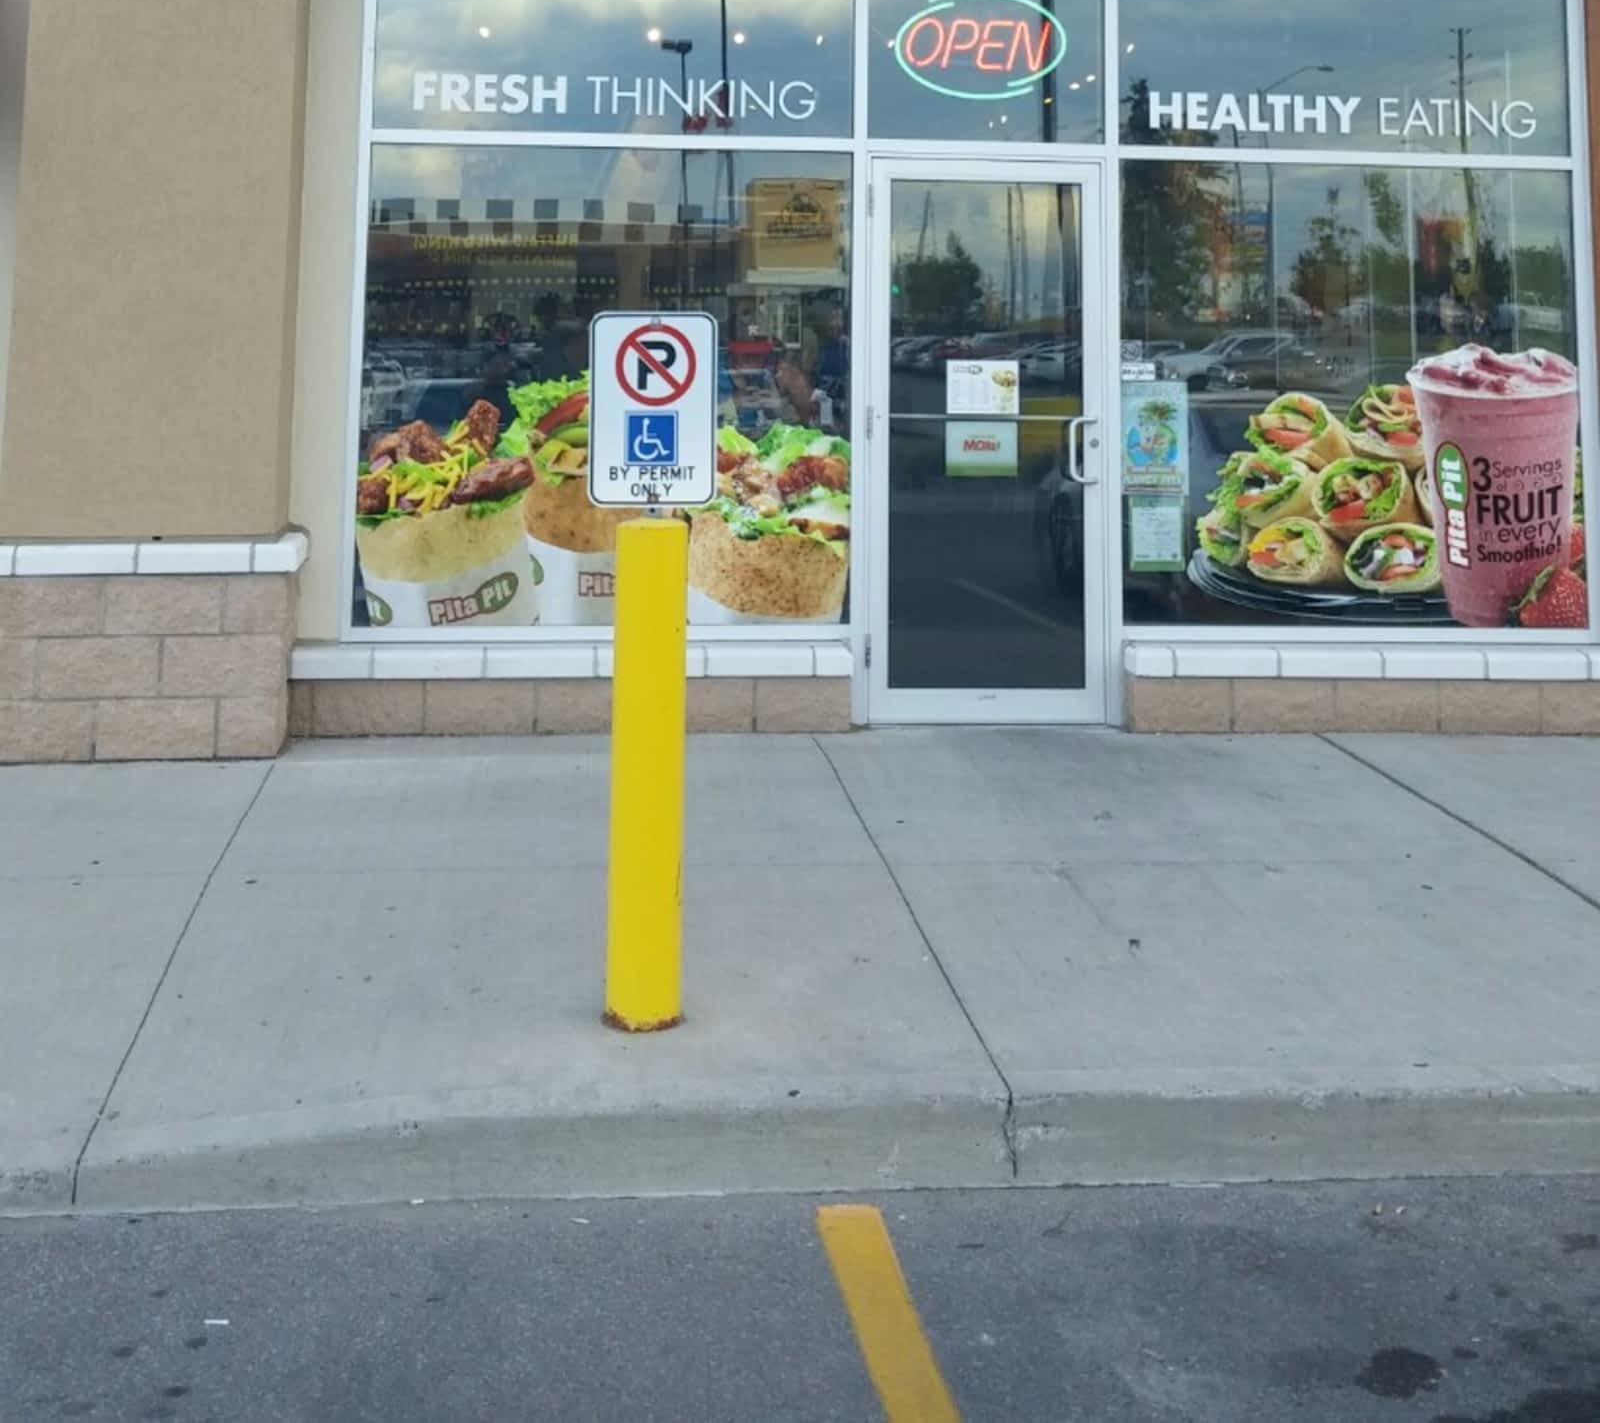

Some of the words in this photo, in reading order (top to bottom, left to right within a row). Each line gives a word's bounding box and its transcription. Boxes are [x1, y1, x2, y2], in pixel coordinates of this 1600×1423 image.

[905, 16, 1053, 72] OPEN
[411, 71, 568, 115] FRESH
[585, 76, 818, 120] THINKING
[1148, 91, 1363, 134] HEALTHY
[1378, 96, 1538, 139] EATING
[608, 466, 630, 481] BY
[638, 466, 696, 482] PERMIT
[630, 483, 673, 497] ONLY
[1441, 458, 1464, 503] Pit
[1472, 456, 1492, 492] 3
[1491, 459, 1563, 479] Servings
[1475, 485, 1564, 525] FRUIT
[1447, 508, 1470, 567] Pita
[1476, 535, 1562, 563] Smoothie!
[1479, 528, 1494, 543] in
[1497, 517, 1562, 544] every
[428, 596, 480, 625] Pita
[480, 577, 514, 609] Pit
